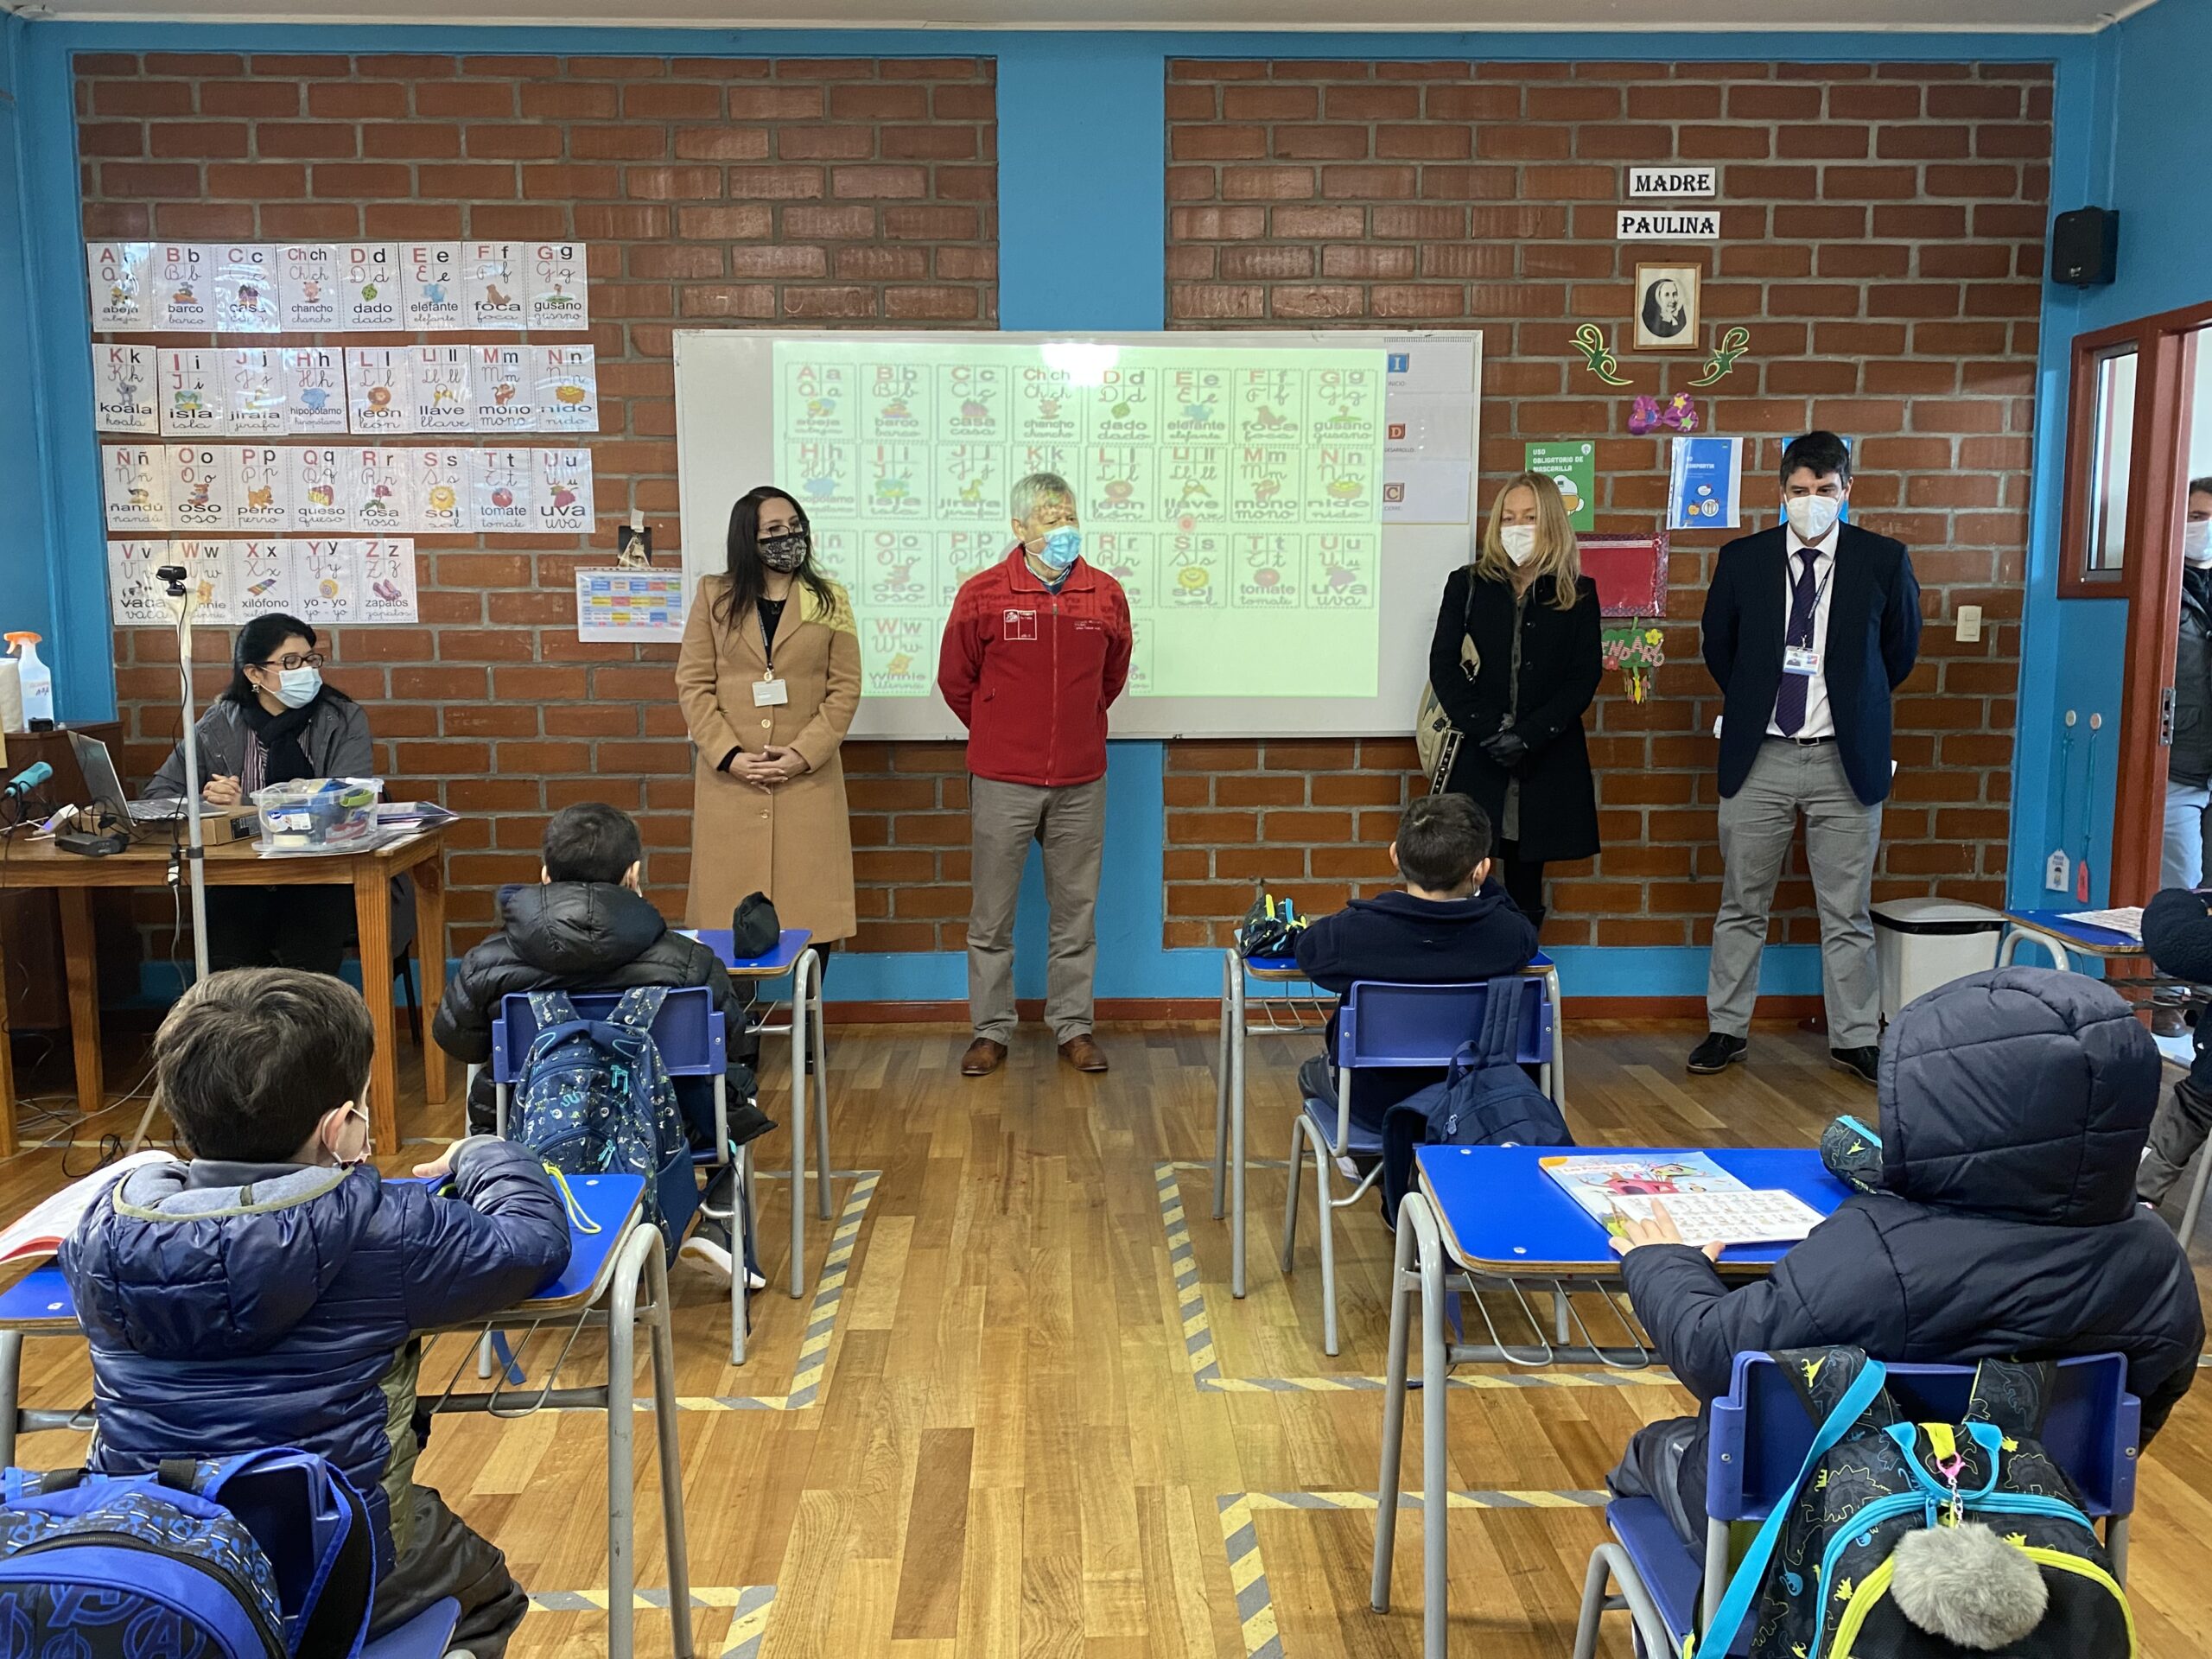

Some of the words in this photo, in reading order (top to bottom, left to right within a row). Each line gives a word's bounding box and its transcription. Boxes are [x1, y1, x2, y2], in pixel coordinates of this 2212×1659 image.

[1635, 174, 1711, 193] MADRE
[1622, 216, 1715, 234] PAULINA
[99, 248, 116, 263] A
[167, 248, 181, 262] B
[188, 249, 200, 263] b
[228, 248, 243, 263] C
[251, 251, 264, 263] c
[288, 248, 306, 261] Ch
[310, 248, 327, 261] ch
[351, 249, 365, 263] D
[373, 248, 385, 263] d
[413, 248, 426, 263] E
[437, 251, 449, 263] e
[478, 246, 490, 258] F
[500, 246, 509, 258] f
[537, 246, 553, 259] G
[560, 246, 573, 260] g
[168, 304, 203, 313] barco
[291, 304, 333, 313] chancho
[353, 302, 392, 313] dado
[410, 302, 458, 312] elefante
[475, 302, 520, 312] foca
[534, 302, 582, 311] gusano
[110, 349, 124, 362] K
[130, 349, 140, 363] k
[236, 353, 246, 365] J
[262, 352, 267, 367] j
[297, 353, 310, 366] H
[319, 353, 329, 366] h
[360, 352, 372, 366] L
[423, 348, 435, 361] Ll
[449, 348, 457, 362] ll
[484, 350, 499, 363] M
[504, 351, 518, 363] m
[548, 350, 563, 364] N
[570, 352, 582, 364] n
[175, 354, 180, 371] I
[876, 366, 894, 381] B
[903, 365, 917, 381] b
[951, 366, 971, 381] C
[980, 370, 995, 381] c
[1103, 371, 1120, 385] D
[1129, 370, 1145, 385] d
[1176, 372, 1192, 385] E
[1204, 374, 1220, 385] e
[1320, 372, 1340, 385] G
[1348, 371, 1364, 385] g
[99, 402, 152, 415] koala
[169, 409, 212, 418] isla
[290, 406, 341, 416] hipopótamo
[420, 405, 464, 415] llave
[479, 405, 531, 415] mono
[117, 448, 130, 465] Ñ
[138, 452, 149, 465] ñ
[179, 448, 194, 464] O
[200, 452, 213, 464] o
[243, 449, 255, 464] P
[264, 449, 276, 465] p
[303, 450, 318, 465] Q
[324, 449, 334, 465] q
[362, 451, 377, 466] R
[386, 454, 394, 466] r
[424, 452, 438, 467] S
[448, 455, 457, 467] s
[484, 453, 497, 467] T
[507, 453, 515, 467] t
[543, 453, 558, 467] U
[566, 456, 576, 467] u
[1244, 448, 1263, 462] M
[1268, 450, 1287, 462] m
[111, 502, 162, 512] ñandú
[178, 504, 221, 512] oso
[238, 506, 284, 516] perro
[298, 507, 345, 517] queso
[359, 507, 399, 518] rosa
[481, 506, 526, 516] tomate
[541, 506, 586, 517] uva
[181, 543, 200, 557] W
[204, 546, 219, 558] w
[247, 543, 259, 557] X
[267, 546, 276, 557] x
[308, 542, 321, 555] Y
[327, 542, 338, 555] y
[365, 543, 379, 557] Z
[389, 546, 399, 556] z
[1320, 537, 1338, 550] U
[1347, 538, 1361, 550] u
[121, 544, 134, 559] V
[142, 548, 151, 558] v
[241, 598, 289, 608] xilófono
[365, 599, 409, 608] zapatos
